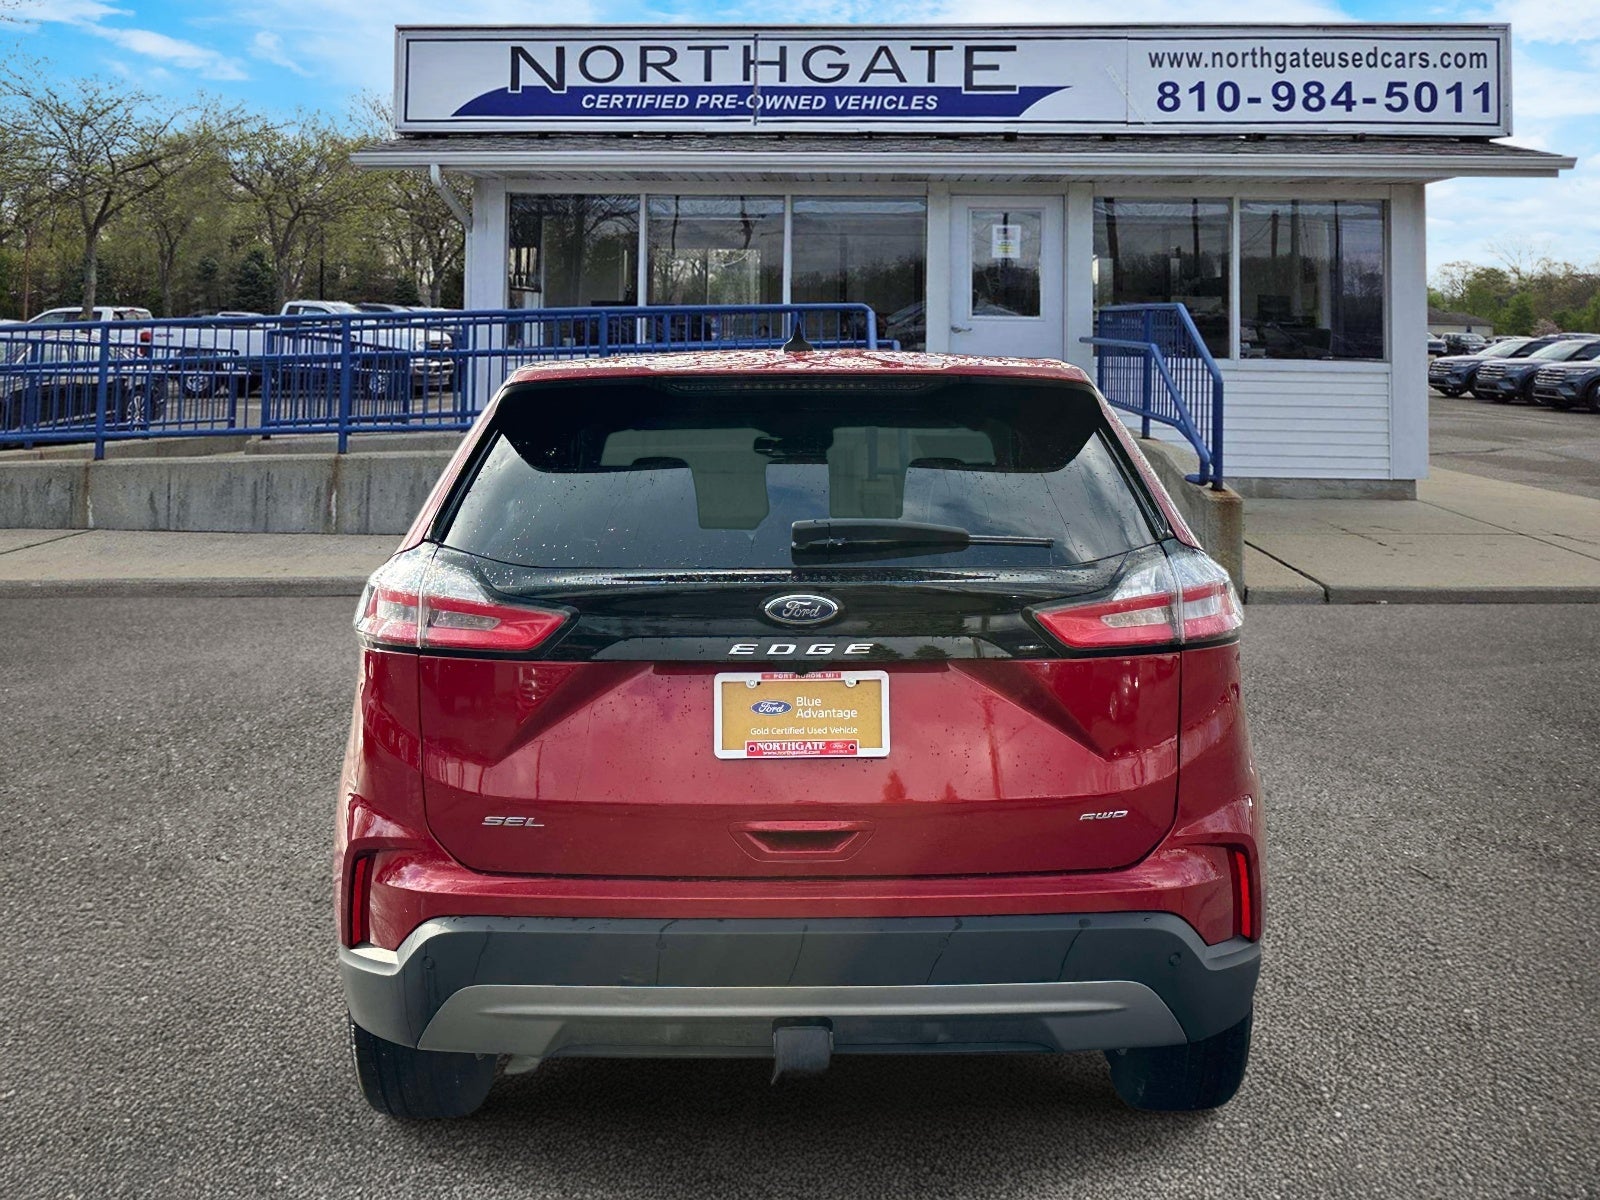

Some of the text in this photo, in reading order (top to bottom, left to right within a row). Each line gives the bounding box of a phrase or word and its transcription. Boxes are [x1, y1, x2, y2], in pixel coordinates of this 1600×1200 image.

[1148, 46, 1489, 74] www.northgateusedcars.com
[509, 44, 1018, 93] NORTHGATE
[581, 94, 939, 111] CERTIFIED PRE-OWNED VEHICLES
[1156, 80, 1491, 113] 810-984-5011
[782, 600, 821, 618] Ford
[728, 643, 874, 655] EDGE
[758, 701, 784, 713] Ford
[796, 696, 822, 707] Blue
[796, 708, 858, 719] Advantage
[750, 726, 858, 735] Gold Certified Used Vehicle
[756, 742, 826, 751] NORTHGATE
[481, 816, 545, 827] SEL
